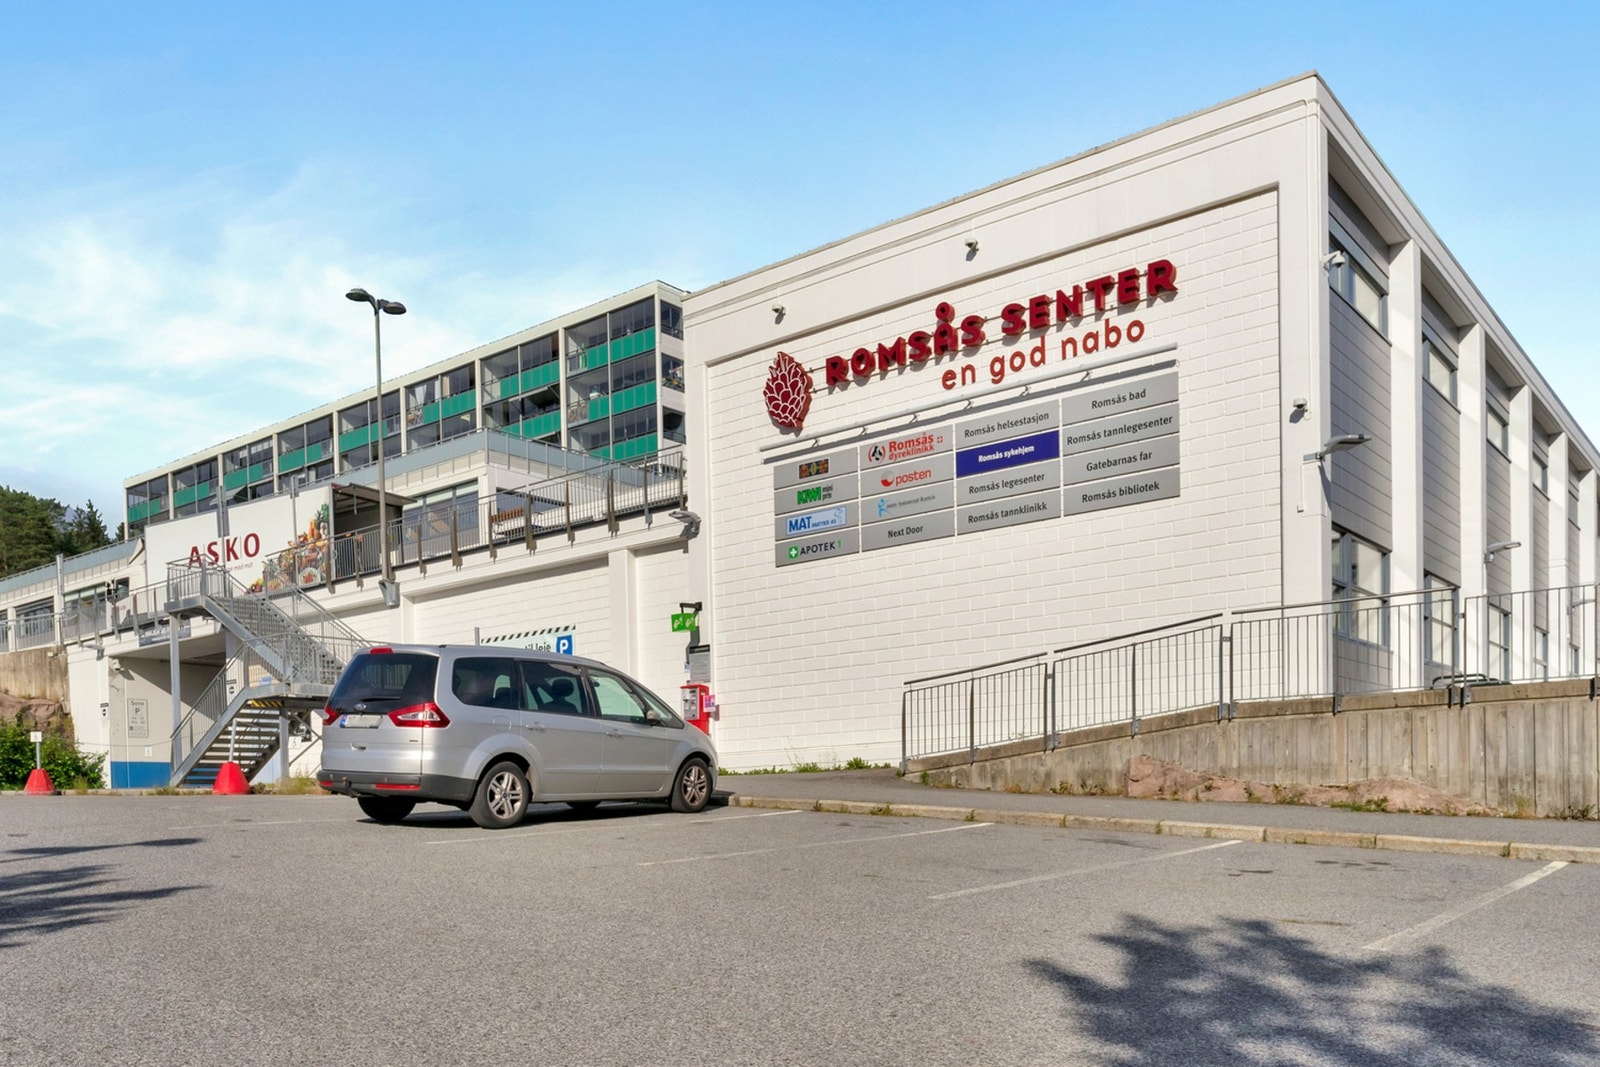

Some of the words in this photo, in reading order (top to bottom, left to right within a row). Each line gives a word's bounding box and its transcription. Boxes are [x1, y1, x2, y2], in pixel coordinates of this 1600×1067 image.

[825, 302, 988, 386] ROMSÅS
[1000, 259, 1178, 336] SENTER
[941, 363, 976, 390] en
[989, 336, 1046, 384] god
[1061, 318, 1145, 360] nabo
[1091, 395, 1127, 409] Romsås
[1129, 388, 1146, 401] bad
[964, 422, 996, 438] Romsås
[996, 411, 1050, 431] helsestasjon
[1067, 431, 1102, 445] Romsås
[1103, 416, 1173, 438] tannlegesenter
[888, 432, 934, 453] Romsås
[888, 444, 935, 462] dyreklinikk
[978, 451, 1003, 462] Romsås
[1004, 444, 1035, 460] sykehjem
[1086, 456, 1138, 472] Gatebarnas
[1139, 451, 1153, 462] far
[895, 469, 932, 487] posten
[968, 480, 1000, 495] Romsås
[1001, 473, 1045, 490] legesenter
[797, 486, 821, 505] KIWI
[1082, 489, 1117, 503] Romsås
[1119, 481, 1160, 497] bibliotek
[968, 509, 1000, 524] Romsås
[1000, 502, 1048, 518] tannklinikk
[789, 516, 812, 532] MAT
[888, 529, 905, 539] Next
[905, 525, 923, 535] Door
[188, 532, 260, 570] ASKO
[800, 541, 836, 556] APOTEK
[837, 540, 841, 549] 1
